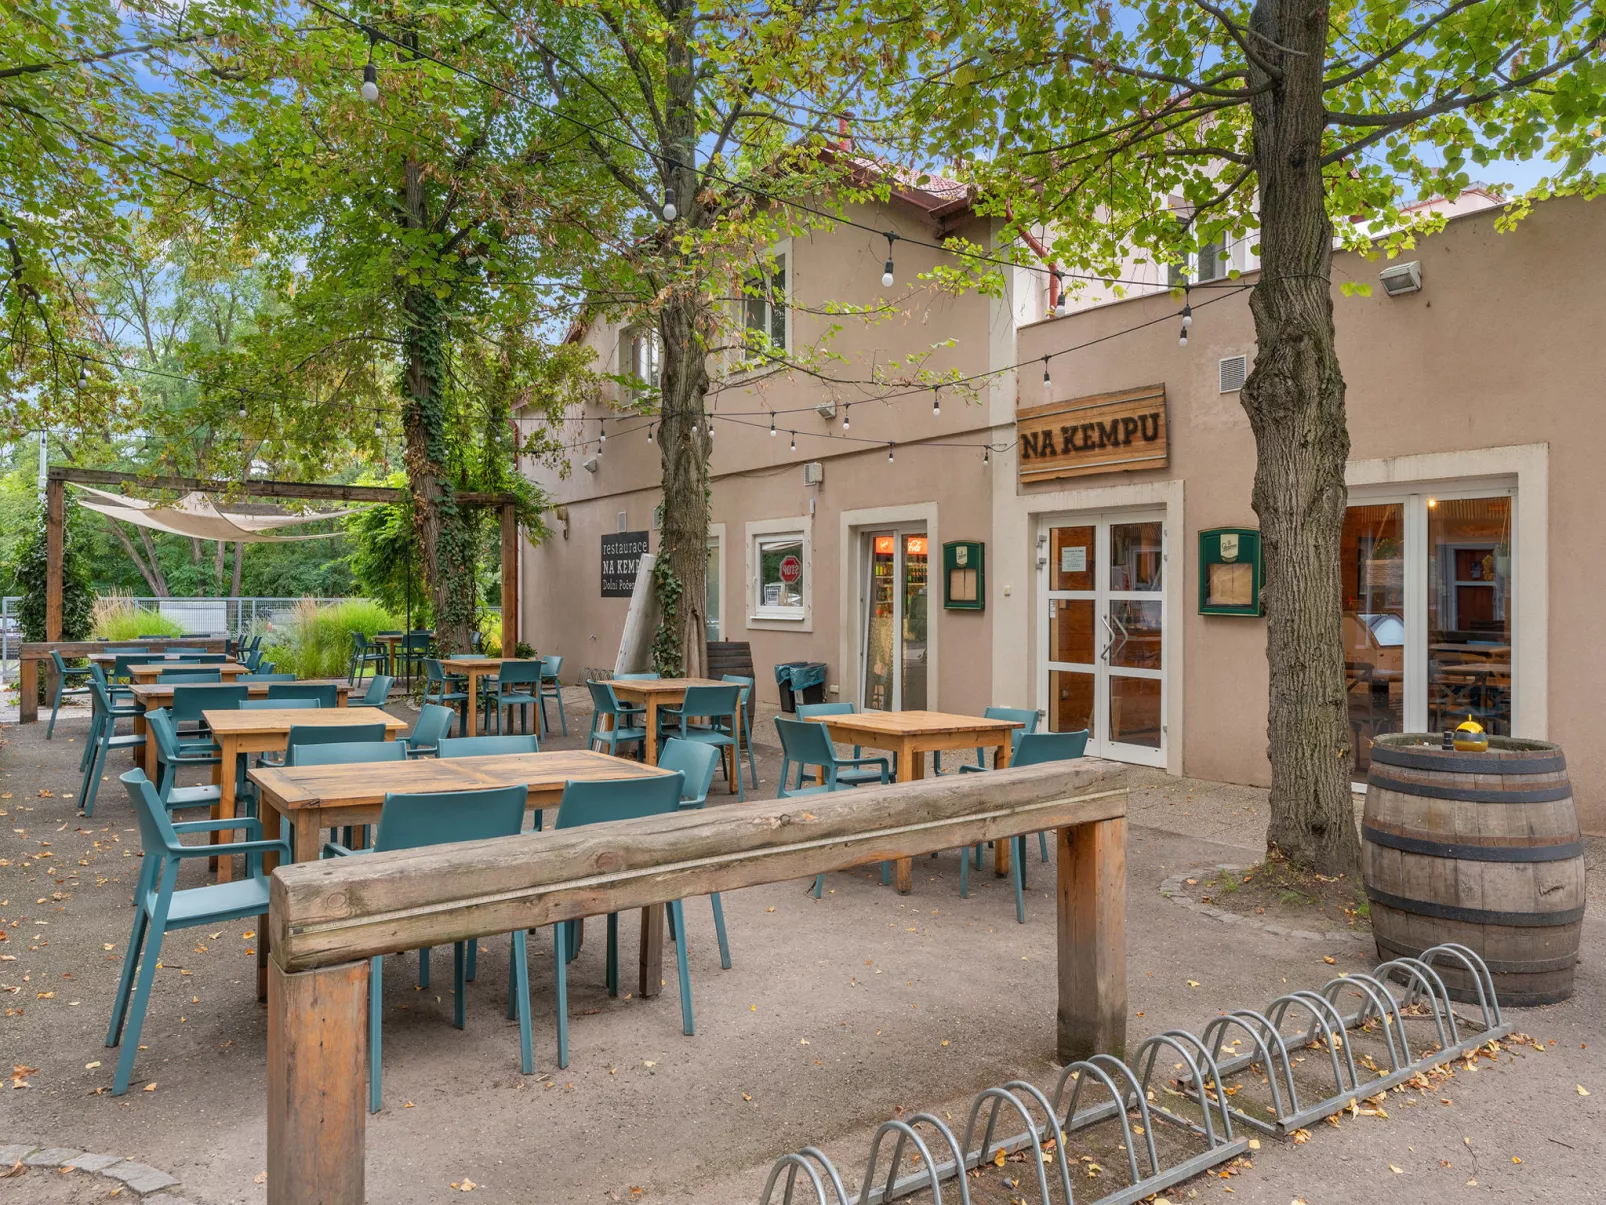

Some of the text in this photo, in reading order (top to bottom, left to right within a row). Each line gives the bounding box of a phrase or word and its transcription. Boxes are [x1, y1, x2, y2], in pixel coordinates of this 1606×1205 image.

[1020, 412, 1160, 459] NA KEMPU
[603, 541, 648, 555] restaurace
[603, 559, 641, 574] NA KEMP
